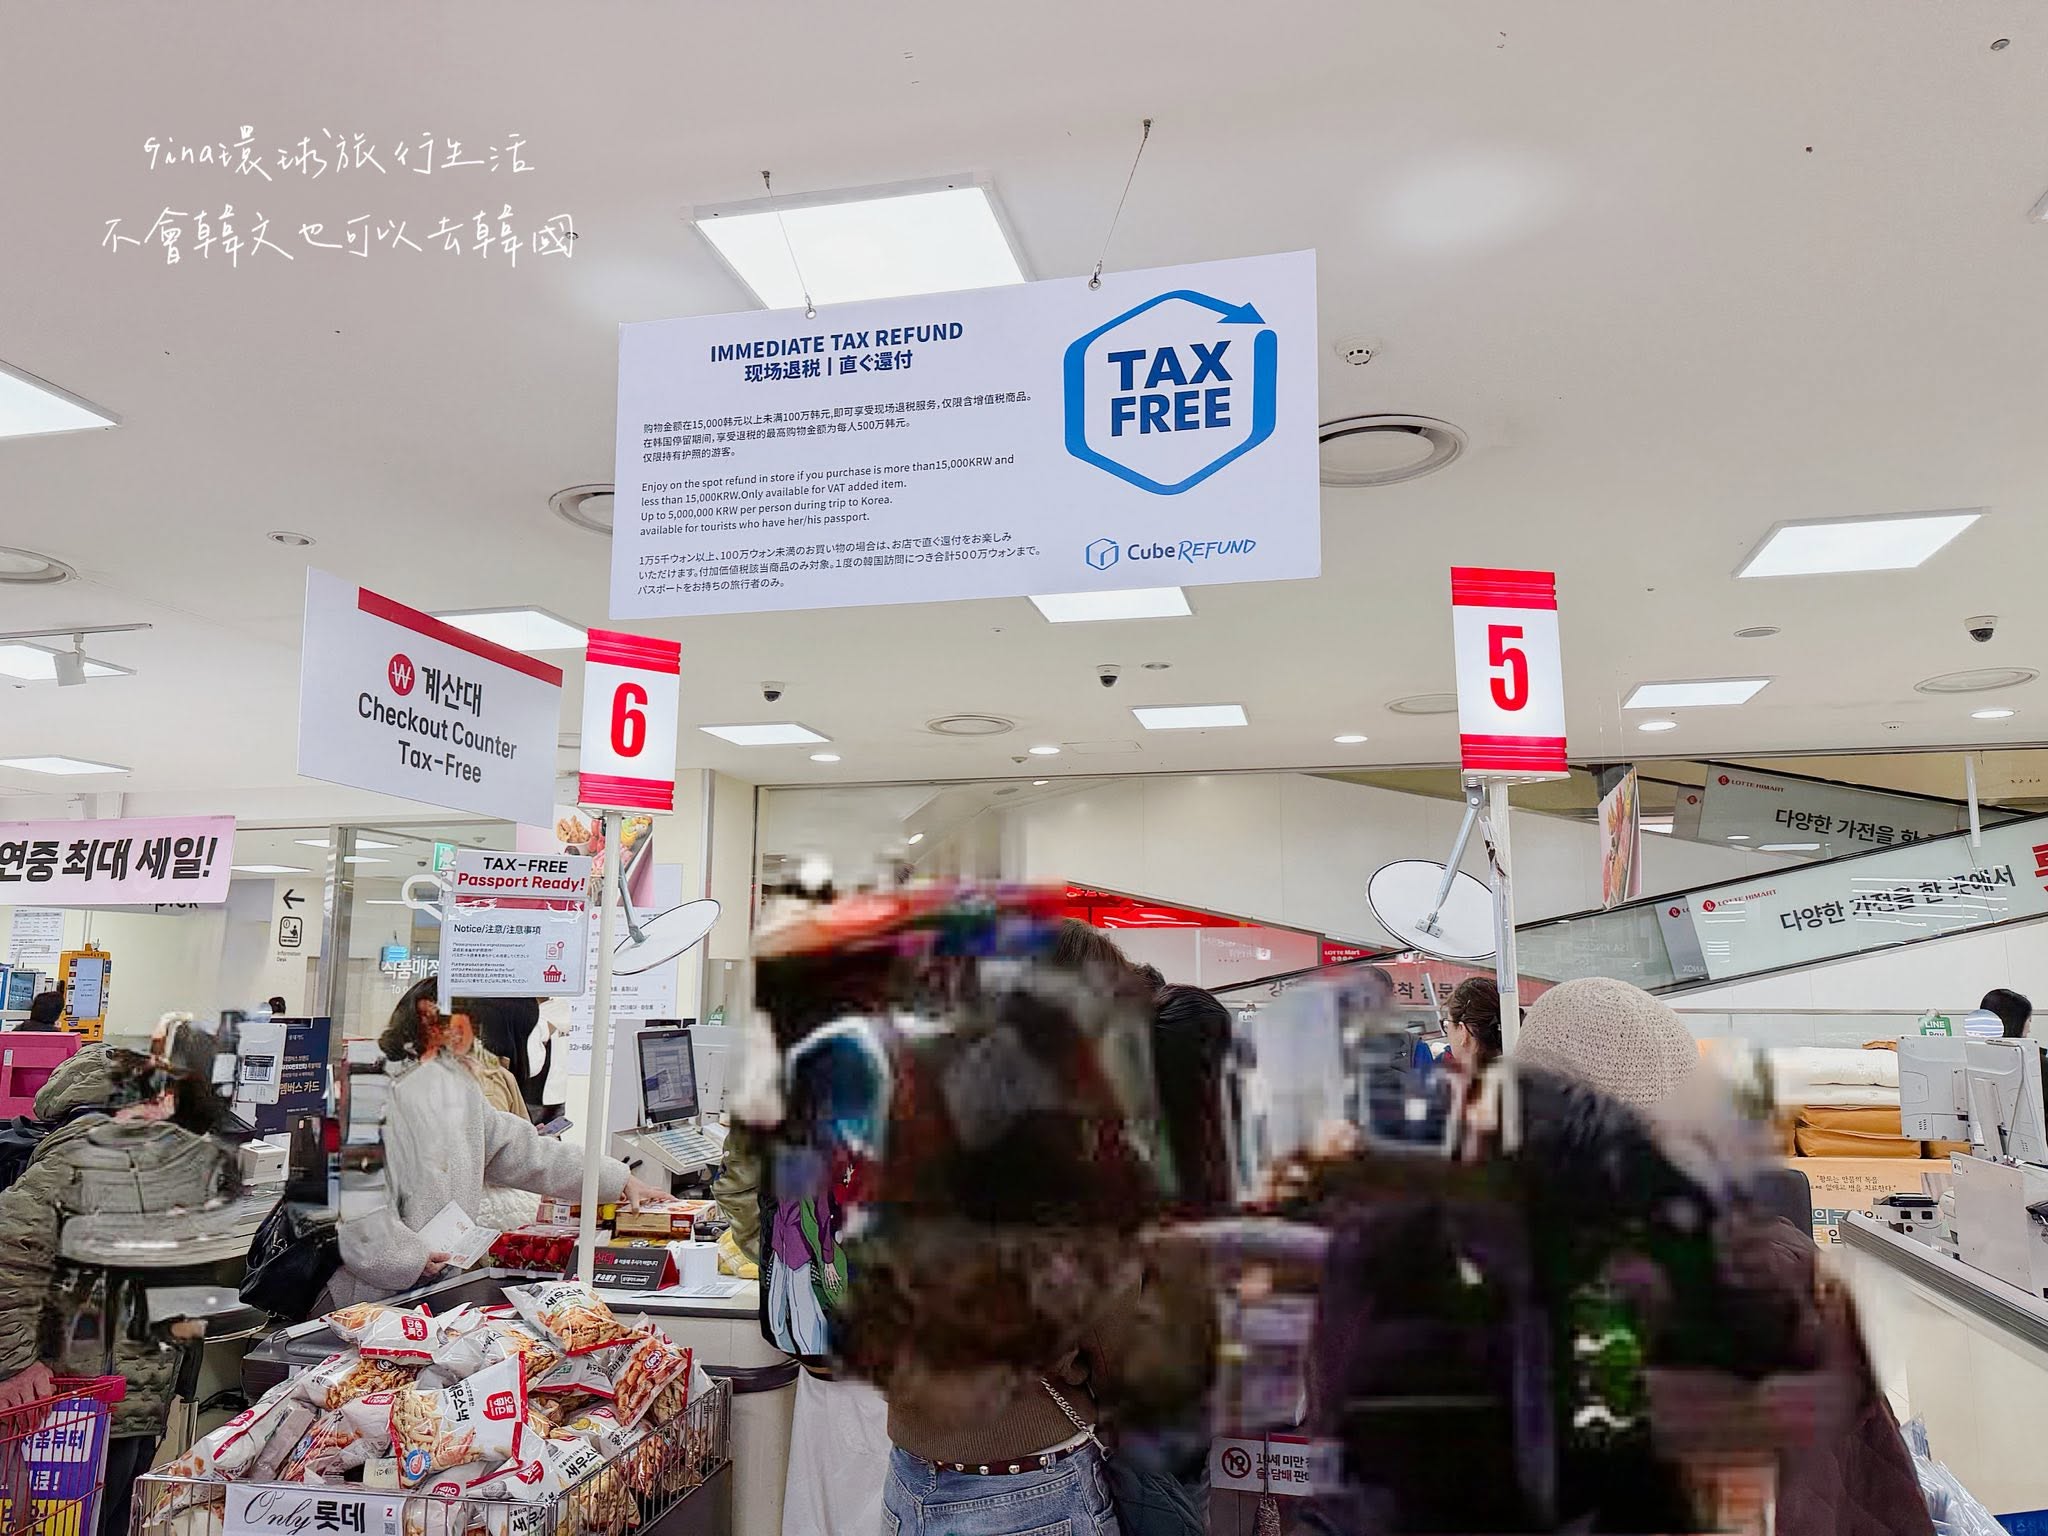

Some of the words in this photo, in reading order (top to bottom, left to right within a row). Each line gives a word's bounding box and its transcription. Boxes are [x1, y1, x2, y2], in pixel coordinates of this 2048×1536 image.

[710, 335, 825, 363] IMMEDIATE
[831, 331, 869, 351] TAX
[875, 322, 964, 347] REFUND
[744, 357, 821, 383] 现场退税
[839, 349, 914, 375] 直ぐ還付
[1107, 340, 1233, 392] TAX
[1111, 387, 1231, 437] FREE
[642, 447, 736, 463] 仅限持有护照的游客。
[642, 482, 668, 493] Enjoy
[670, 482, 682, 490] on
[684, 478, 700, 489] the
[702, 477, 723, 489] spot
[725, 474, 757, 487] refund
[759, 473, 768, 483] in
[770, 472, 795, 483] store
[797, 470, 805, 481] if
[806, 471, 824, 484] you
[826, 466, 871, 480] purchase
[873, 465, 881, 475] is
[884, 464, 910, 474] more
[912, 456, 992, 472] than15,000KRW
[995, 454, 1014, 465] and
[641, 497, 659, 507] less
[661, 494, 683, 505] than
[685, 489, 763, 504] 15,000KRW.Only
[766, 485, 809, 498] available
[811, 484, 825, 494] for
[828, 483, 845, 493] VAT
[848, 480, 879, 492] added
[881, 479, 907, 489] item.
[640, 523, 682, 536] available
[685, 521, 698, 532] for
[701, 519, 737, 532] tourists
[739, 518, 760, 529] who
[762, 516, 785, 527] have
[787, 514, 822, 527] her/his
[824, 512, 870, 525] passport.
[641, 512, 654, 523] Up
[656, 512, 666, 520] to
[668, 508, 714, 521] 5,000,000
[716, 506, 738, 516] KRW
[740, 505, 756, 516] per
[758, 502, 792, 515] person
[794, 499, 826, 512] during
[829, 499, 846, 509] trip
[848, 498, 859, 506] to
[861, 495, 892, 505] Korea.
[1127, 542, 1176, 561] Cube
[1178, 538, 1256, 564] REFUND
[1486, 624, 1530, 712] 5
[422, 665, 483, 718] 계산대
[358, 691, 449, 742] Checkout
[452, 721, 517, 760] Counter
[610, 682, 649, 758] 6
[398, 740, 482, 784] Tax-Free
[1731, 779, 1754, 788] LOTTE
[1755, 783, 1784, 793] HIMART
[1775, 808, 1833, 835] 다양한
[1836, 819, 1895, 846] 가전을
[0, 840, 59, 882] 연중
[62, 838, 133, 882] 최대
[135, 835, 219, 880] 세일!
[483, 857, 569, 874] TAX-FREE
[457, 873, 529, 890] Passport
[531, 877, 586, 893] Ready!
[1745, 889, 1777, 902] HIMART
[1780, 901, 1846, 932] 다양한
[1848, 884, 1915, 917] 가전을
[1918, 880, 1942, 904] 한
[453, 924, 542, 935] Notice/注意/注意事項
[1924, 1020, 1945, 1029] LINE
[304, 1081, 320, 1094] 카드
[545, 1289, 586, 1308] 새우스낵
[1282, 1455, 1304, 1469] 미만
[243, 1490, 313, 1536] Only
[314, 1500, 366, 1534] 롯데
